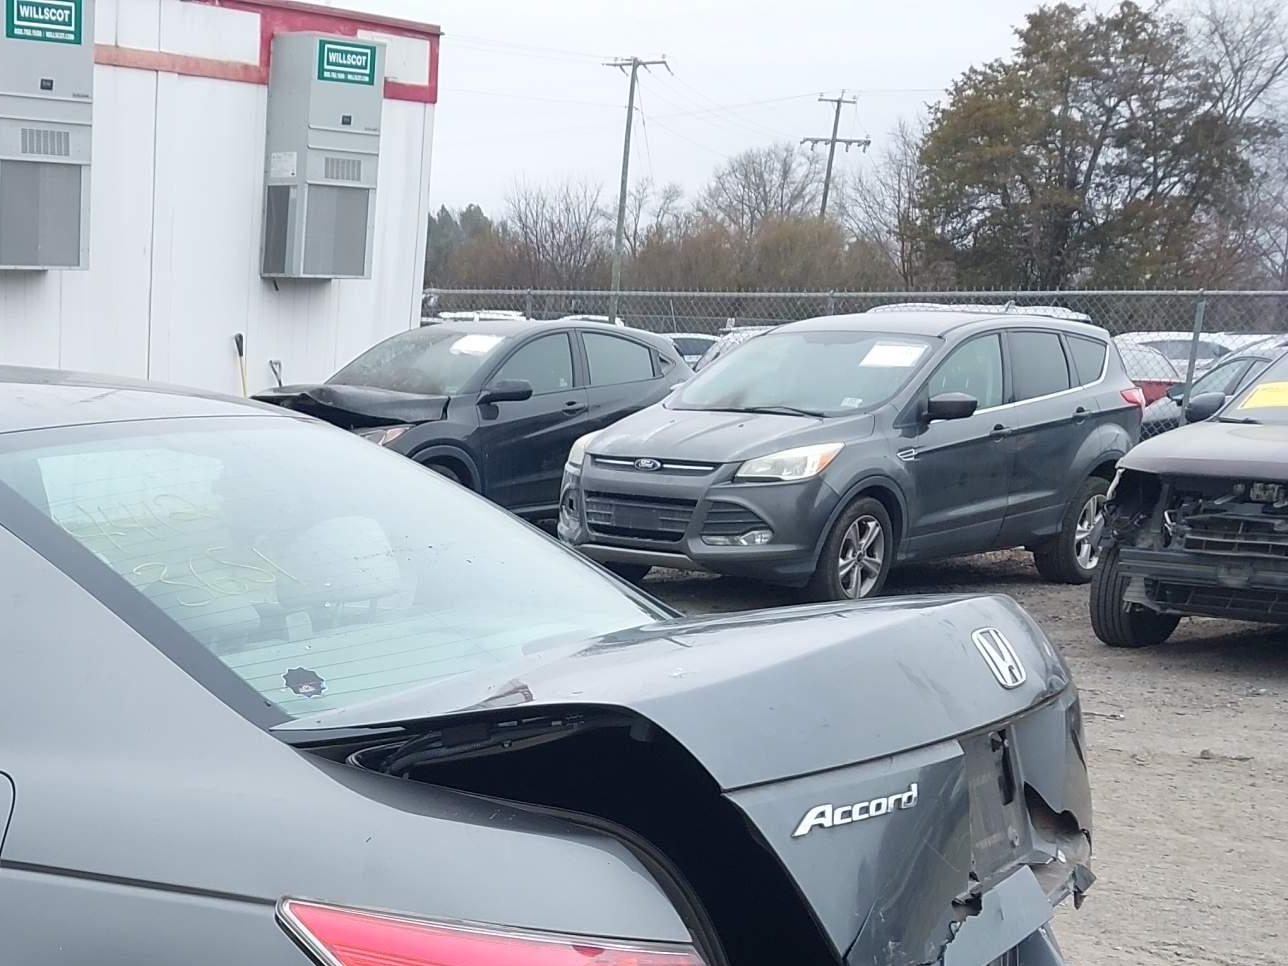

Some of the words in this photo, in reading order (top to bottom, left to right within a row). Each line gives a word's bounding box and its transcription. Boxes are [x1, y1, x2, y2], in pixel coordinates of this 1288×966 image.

[18, 4, 70, 23] WILLSCOT
[328, 51, 367, 67] WILLSCOT
[791, 782, 918, 837] Accord
